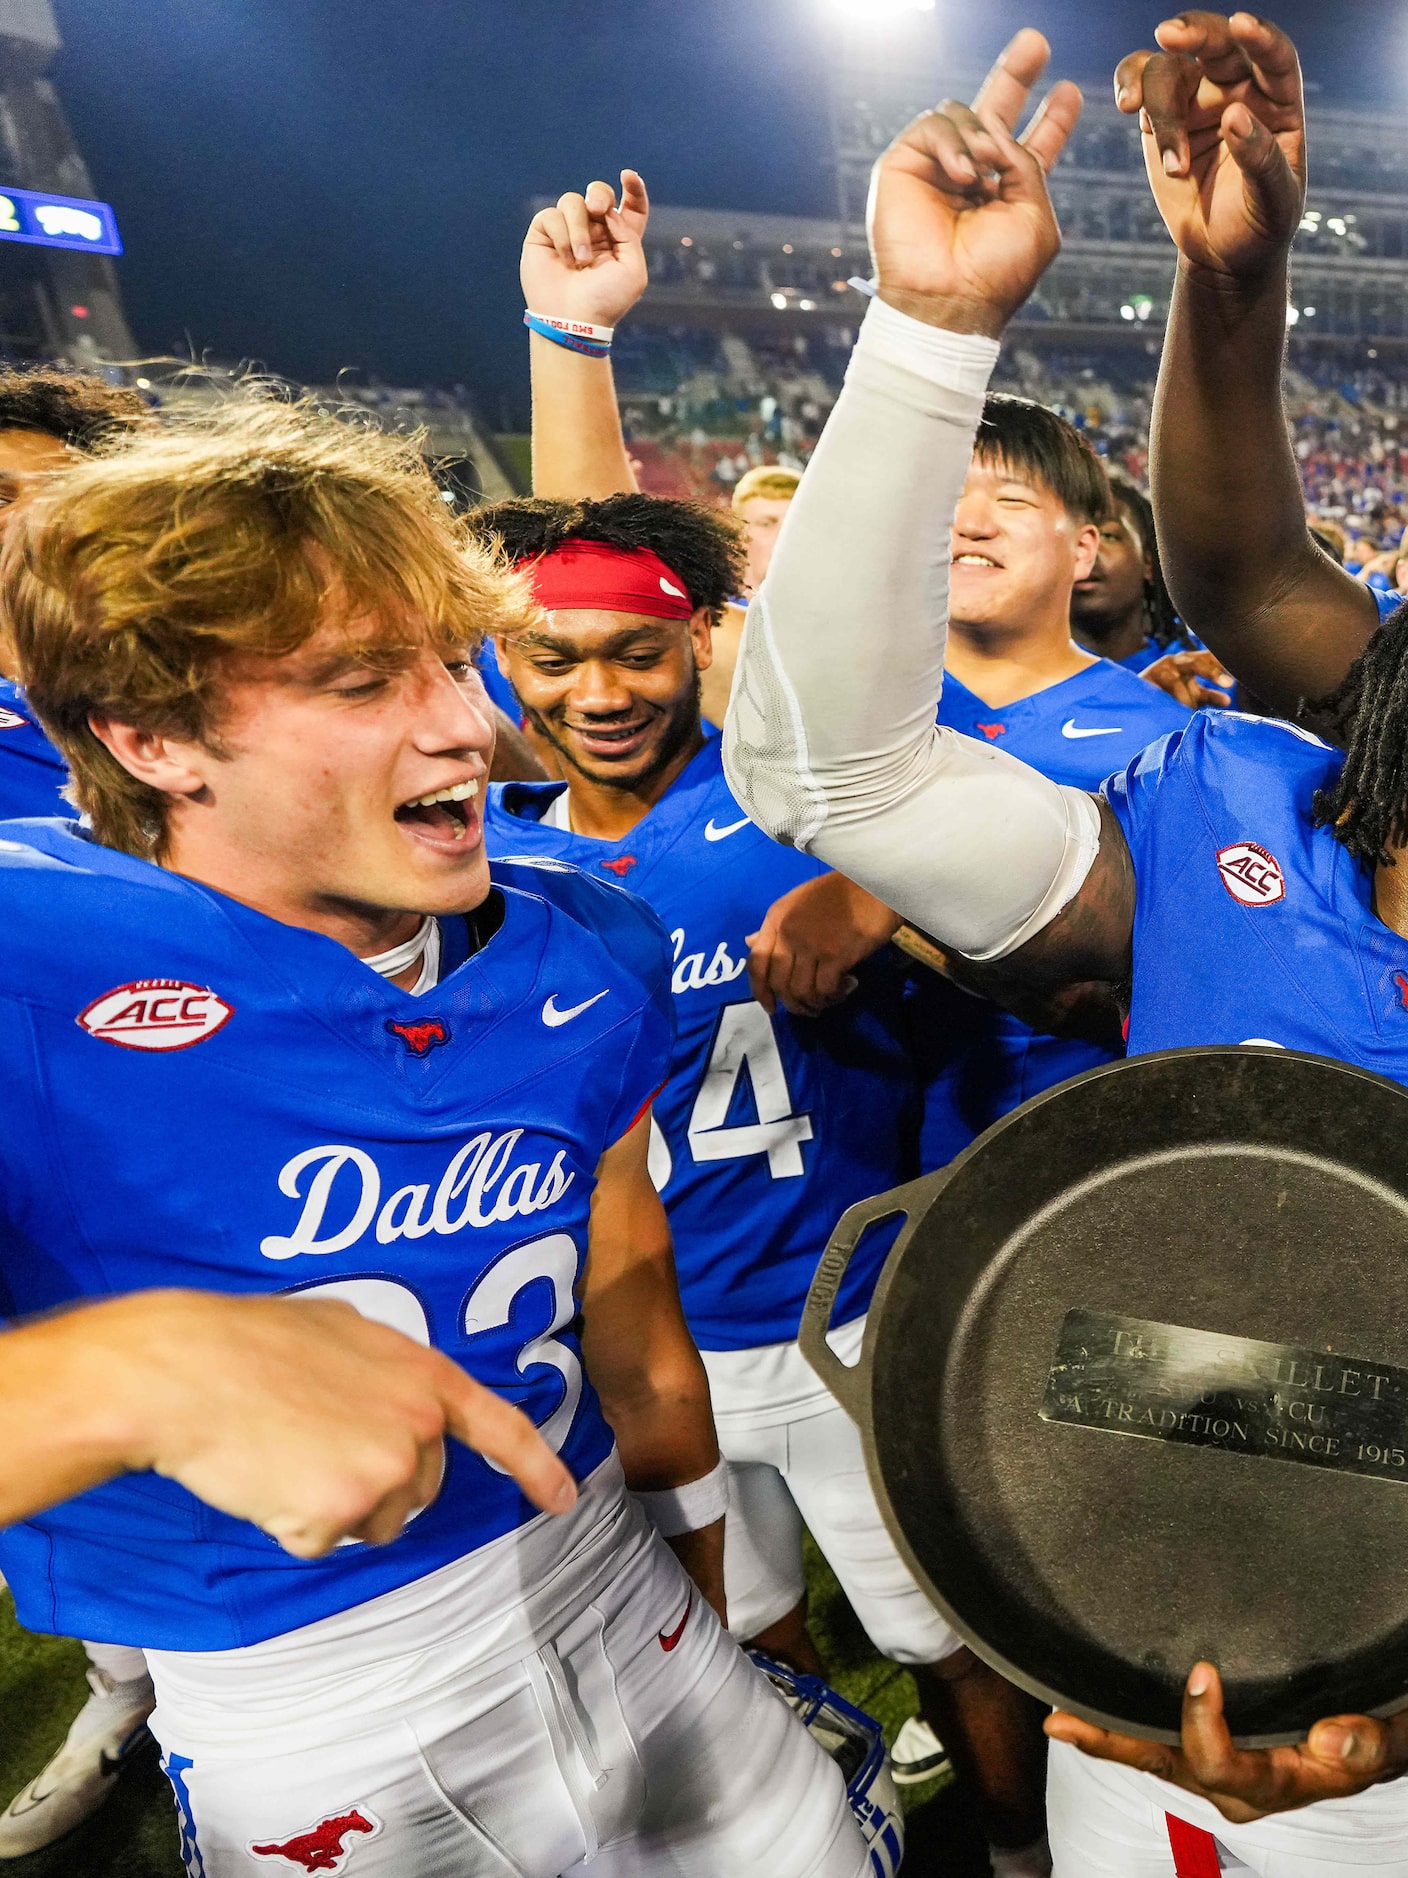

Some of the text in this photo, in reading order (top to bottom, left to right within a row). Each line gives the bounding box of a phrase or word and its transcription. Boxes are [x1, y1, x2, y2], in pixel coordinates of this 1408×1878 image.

[1225, 856, 1279, 892] ACC
[104, 995, 212, 1025] ACC
[647, 1001, 813, 1192] 4
[259, 1128, 576, 1261] Dallas
[283, 1240, 585, 1476] 3
[1101, 1400, 1250, 1441] TRADITION
[1264, 1428, 1340, 1456] SINCE
[1357, 1444, 1406, 1467] 1915
